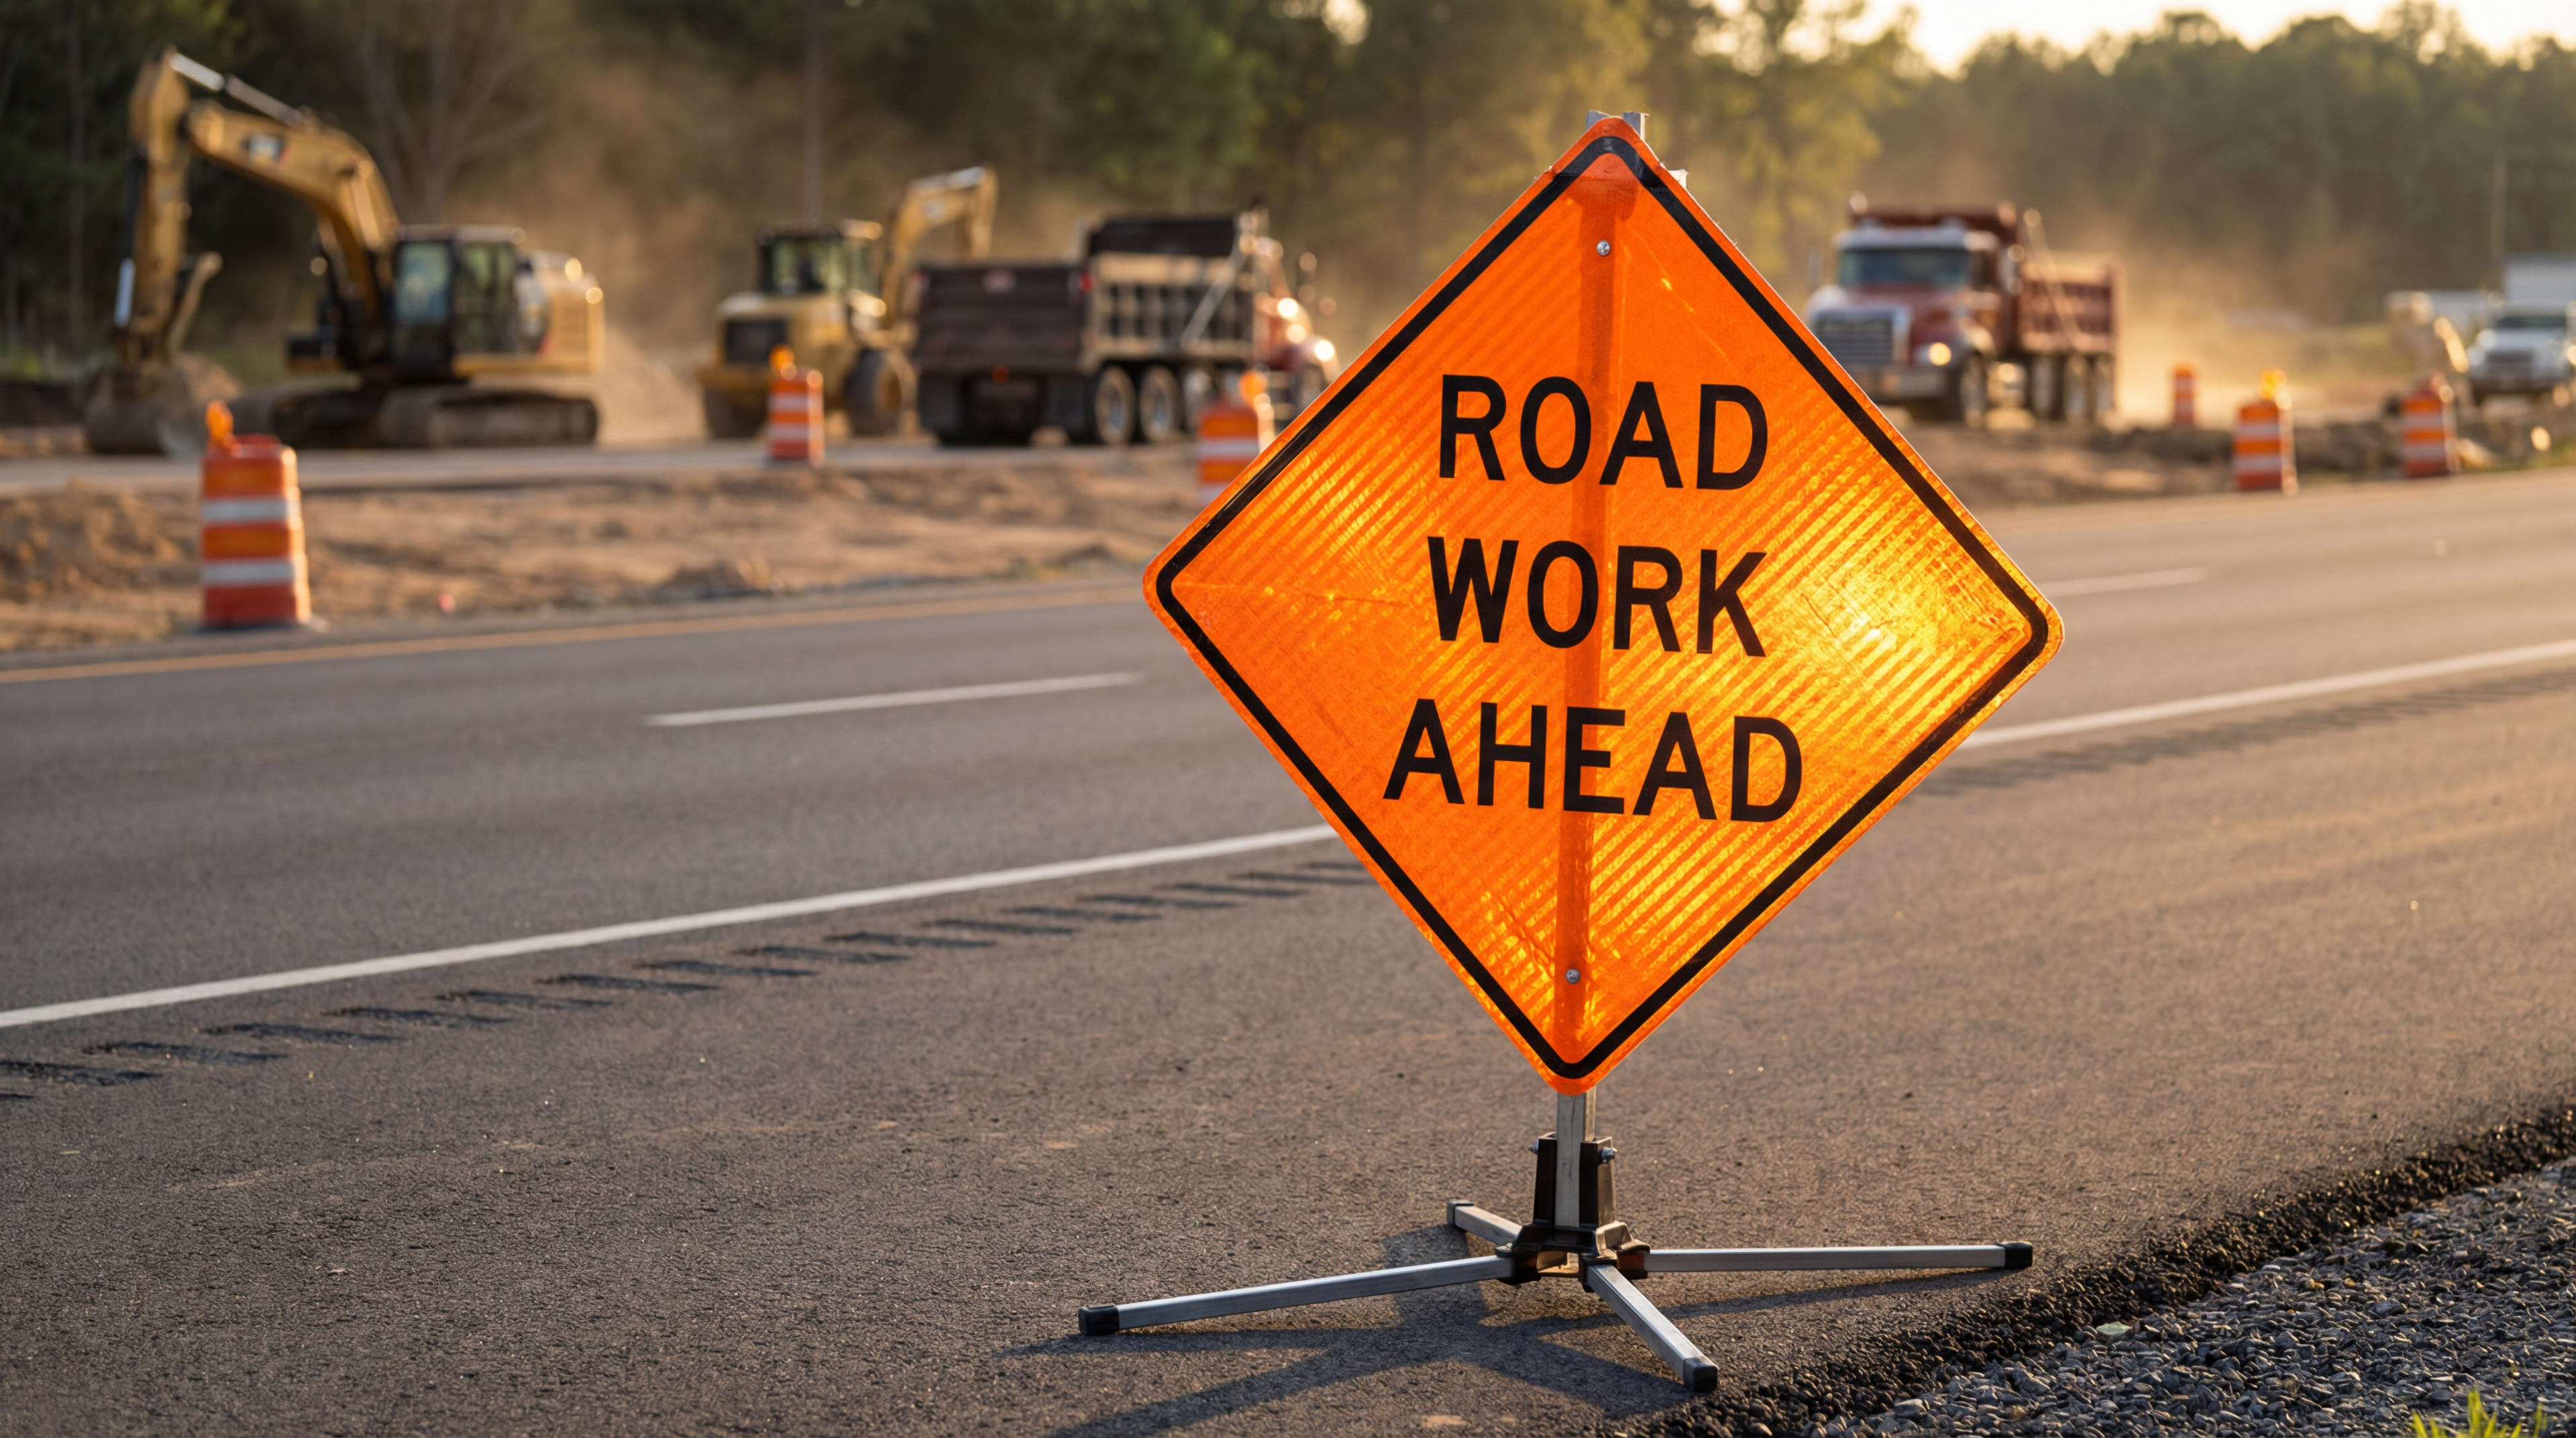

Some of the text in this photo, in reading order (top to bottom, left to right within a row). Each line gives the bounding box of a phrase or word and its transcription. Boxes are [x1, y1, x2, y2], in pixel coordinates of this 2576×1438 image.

[1440, 374, 1768, 490] ROAD
[1428, 536, 1766, 657] WORK
[1383, 699, 1803, 822] AHEAD
